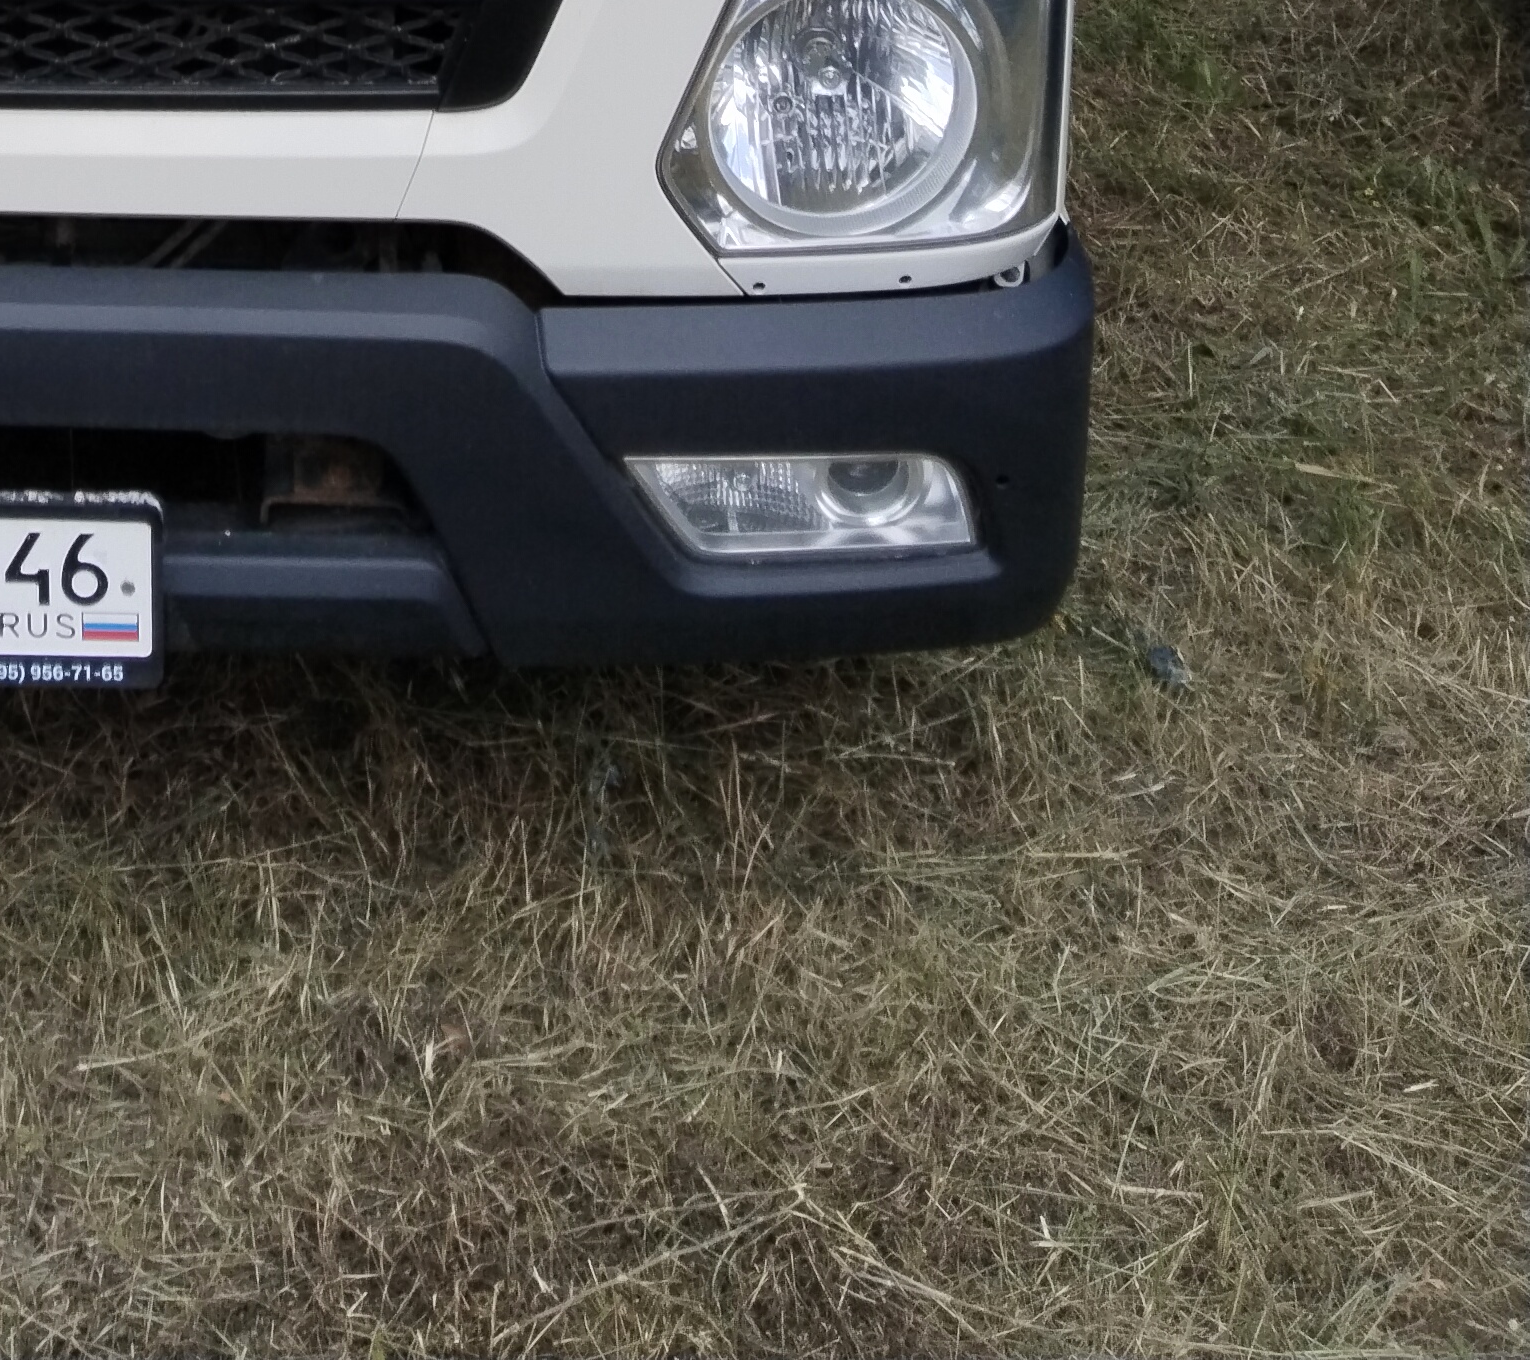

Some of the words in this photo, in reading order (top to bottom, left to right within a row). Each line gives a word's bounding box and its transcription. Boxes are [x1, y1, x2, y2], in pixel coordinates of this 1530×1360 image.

[3, 532, 110, 606] 46
[0, 611, 76, 639] RUS
[30, 664, 125, 682] 956-71-65
